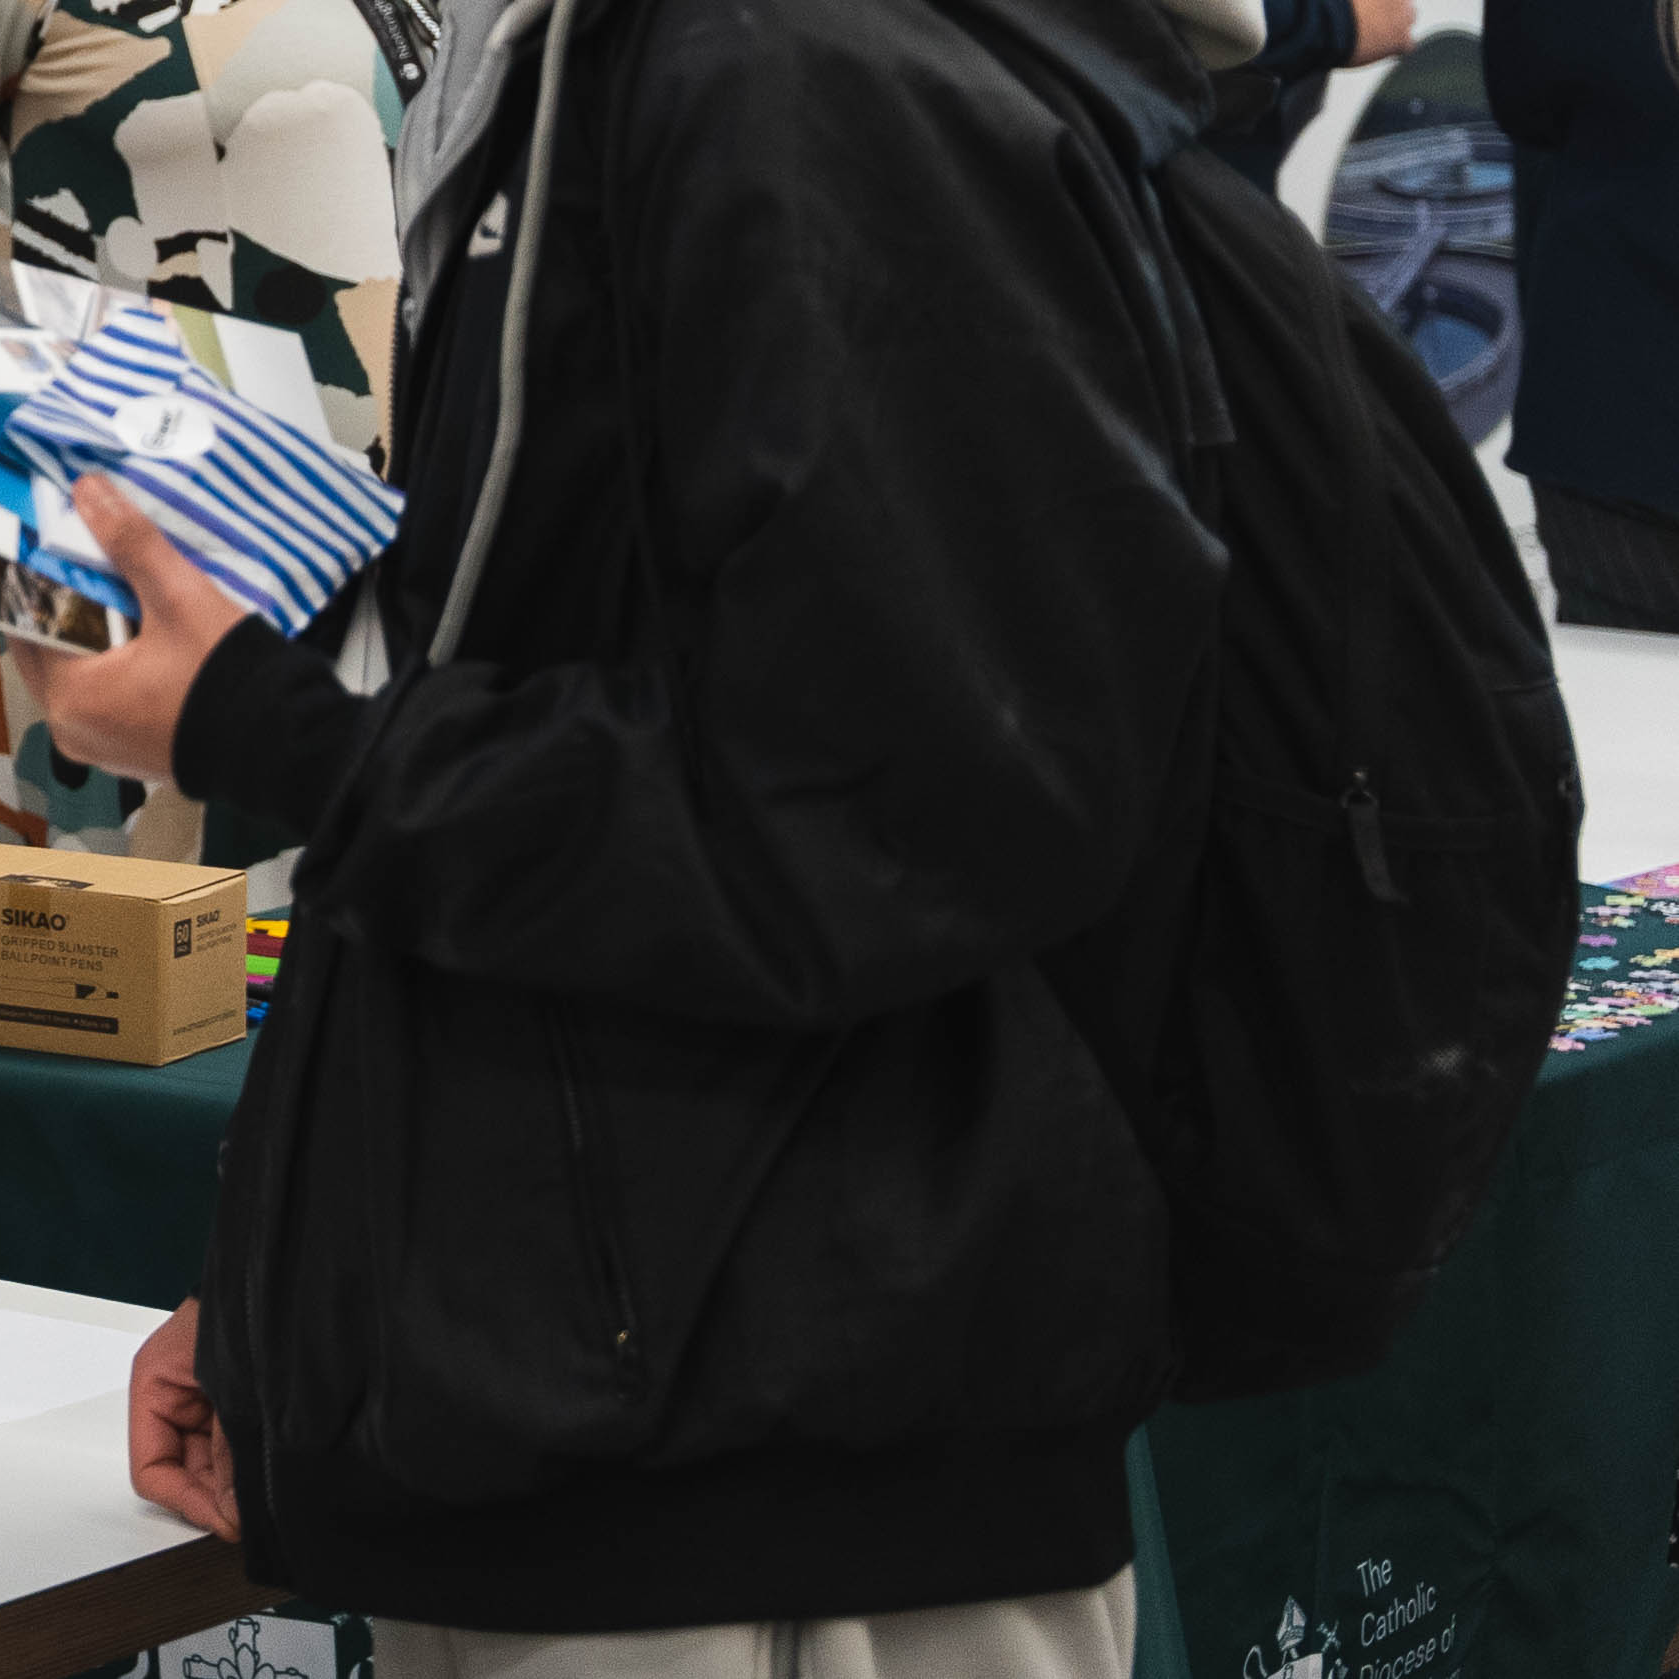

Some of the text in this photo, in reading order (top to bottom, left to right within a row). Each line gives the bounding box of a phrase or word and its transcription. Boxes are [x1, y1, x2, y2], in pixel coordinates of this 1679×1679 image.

[1, 908, 67, 931] SIKAO
[1, 935, 119, 958] GRIPPED SLIMSTER
[1, 951, 103, 971] BALLPOINT PENS
[1356, 1557, 1392, 1597] The
[1361, 1581, 1437, 1648] Catholic
[1441, 1612, 1456, 1654] of
